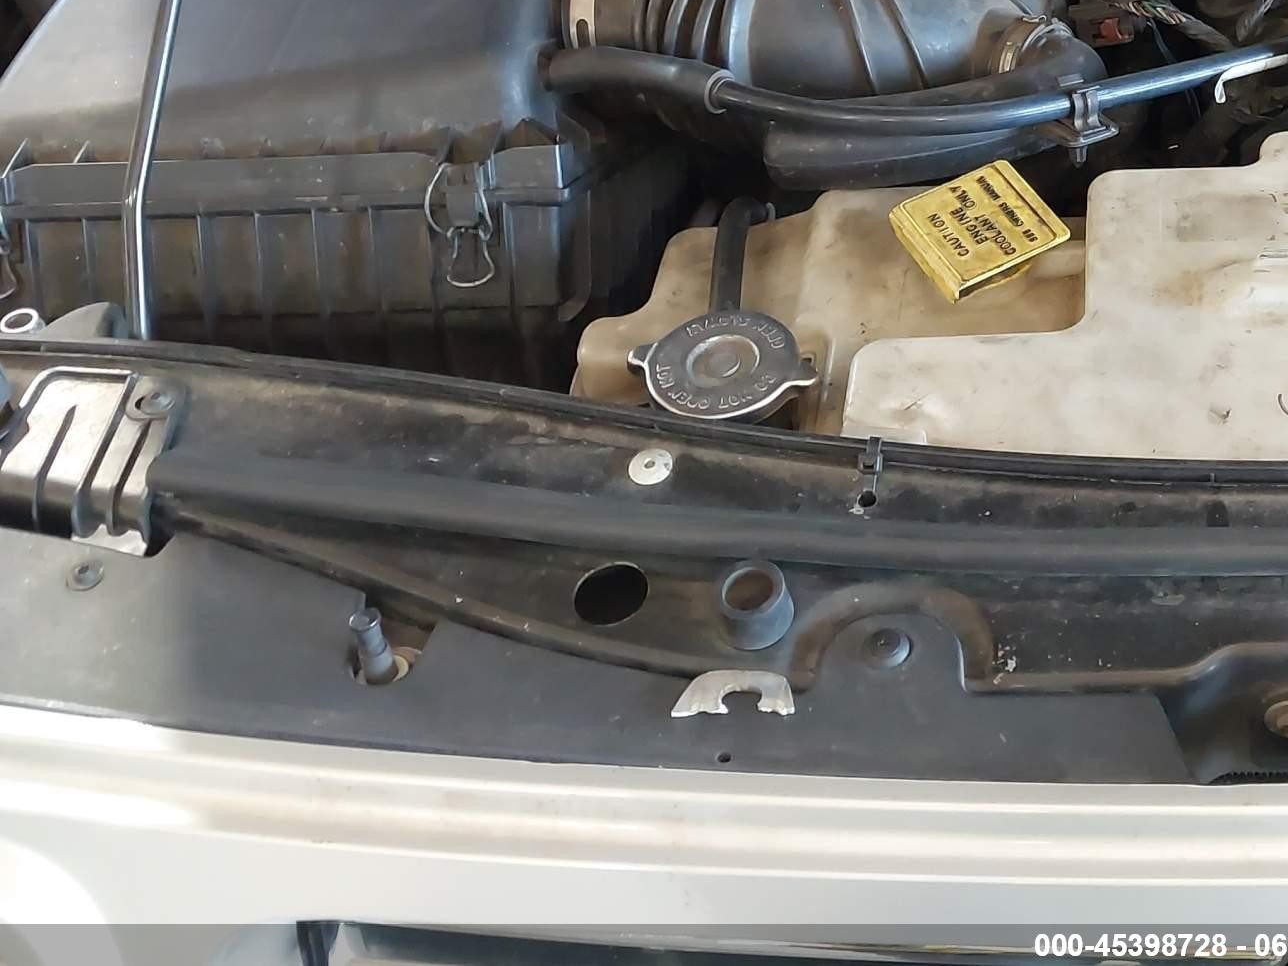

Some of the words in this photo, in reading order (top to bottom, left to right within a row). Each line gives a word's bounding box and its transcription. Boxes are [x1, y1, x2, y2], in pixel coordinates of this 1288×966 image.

[948, 185, 976, 210] ONLY
[928, 213, 971, 258] CAUTION
[948, 206, 989, 246] ENGINE
[974, 213, 1017, 257] COOLANT
